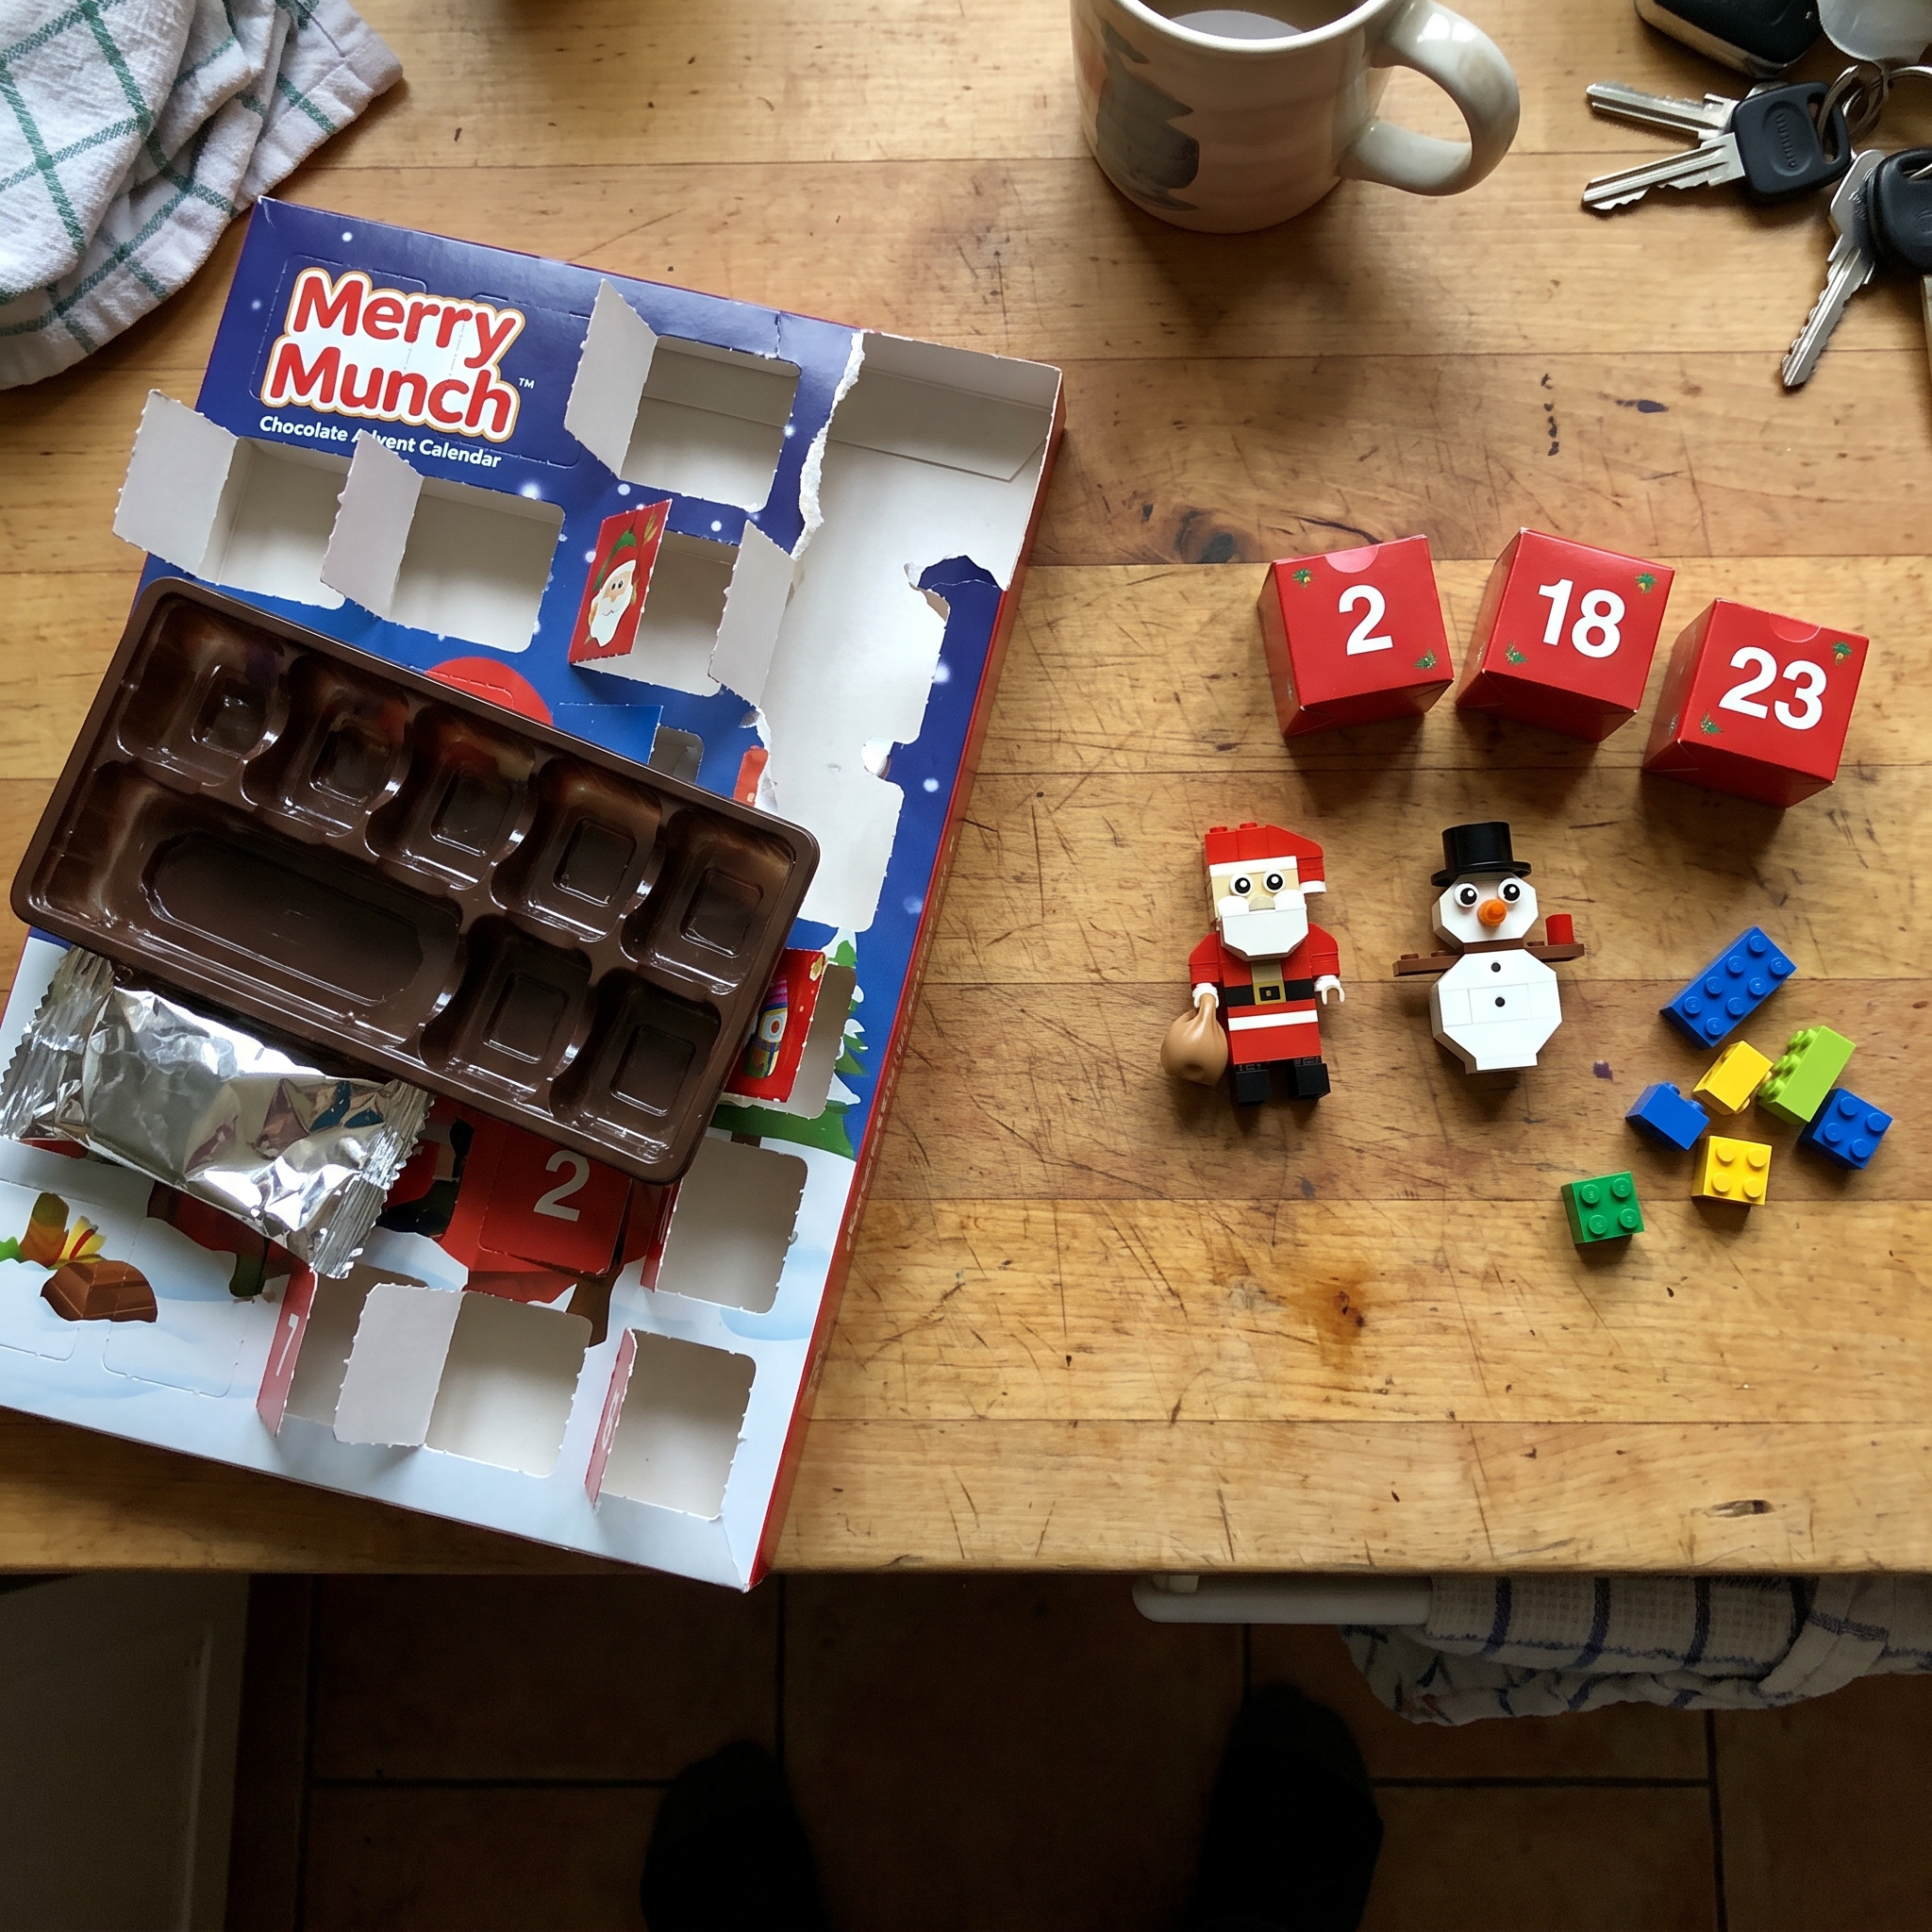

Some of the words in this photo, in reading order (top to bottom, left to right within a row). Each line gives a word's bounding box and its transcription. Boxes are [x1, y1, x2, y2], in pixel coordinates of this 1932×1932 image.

[293, 276, 516, 368] Merry
[270, 343, 512, 433] Munch
[259, 416, 348, 441] Chocolate
[351, 428, 416, 453] Avent
[419, 439, 502, 468] Calendar
[1339, 584, 1394, 656] 2
[1538, 578, 1626, 658] 18
[1718, 646, 1827, 730] 23
[533, 1149, 591, 1223] 2
